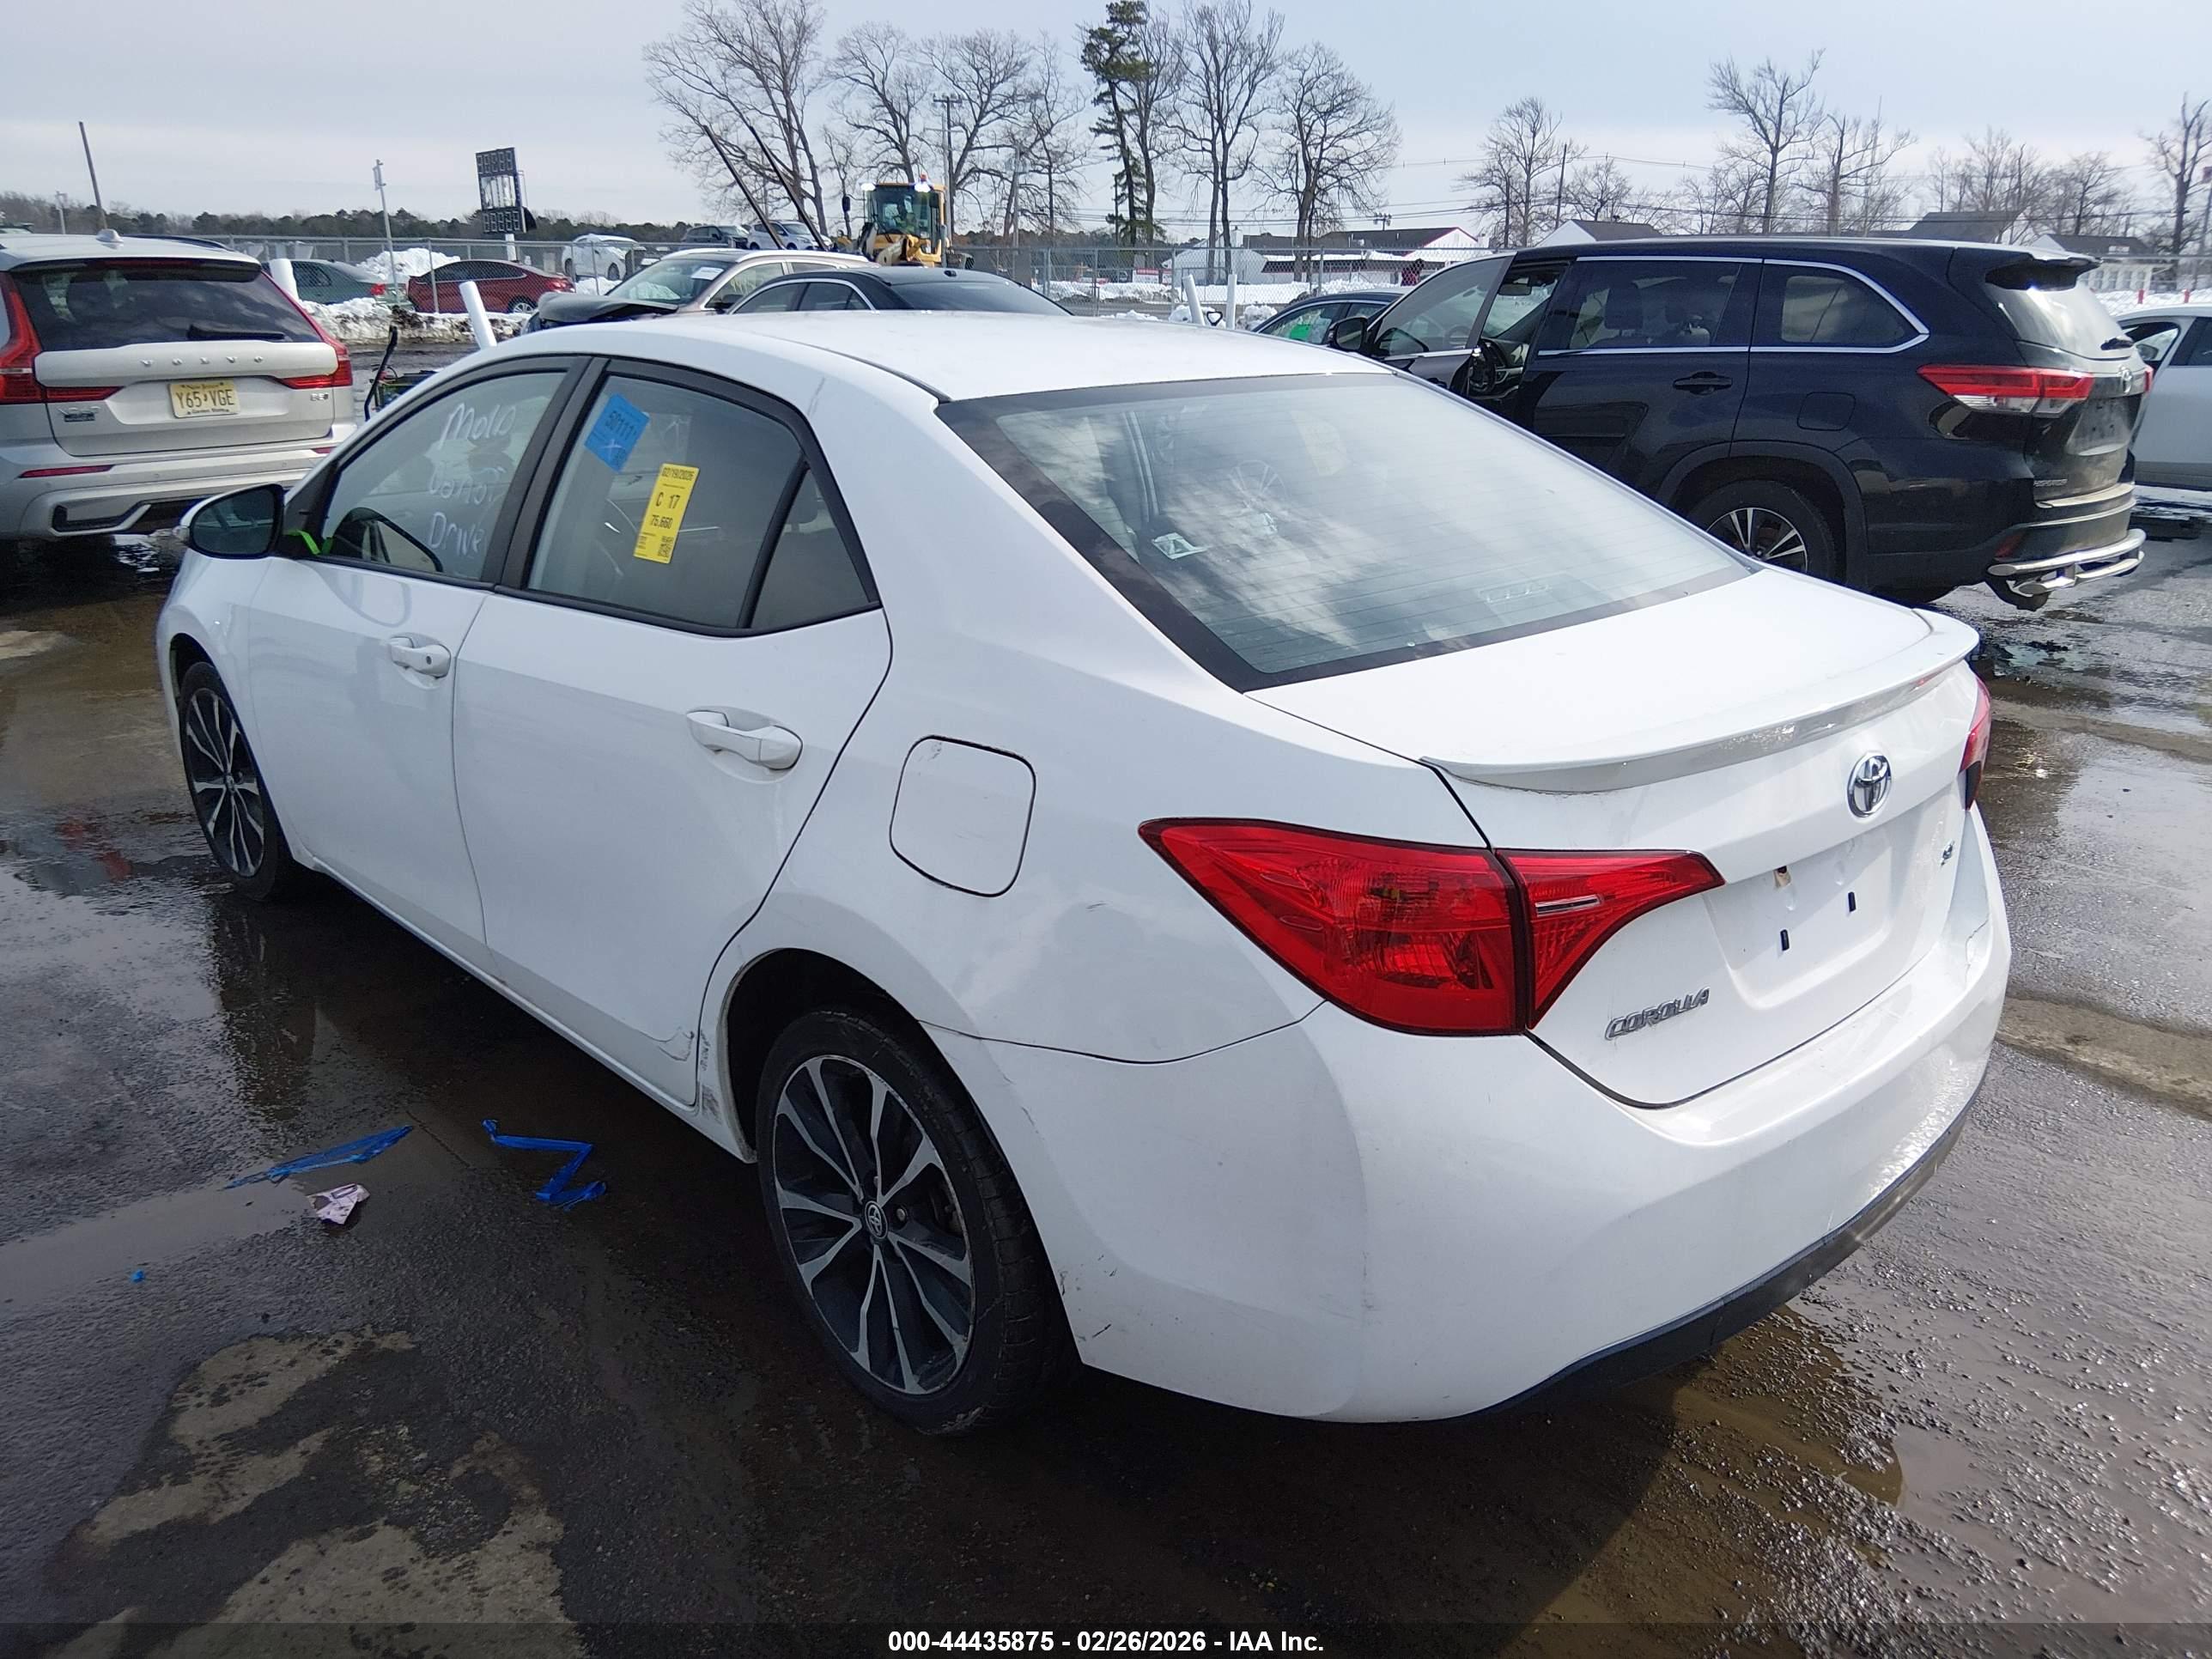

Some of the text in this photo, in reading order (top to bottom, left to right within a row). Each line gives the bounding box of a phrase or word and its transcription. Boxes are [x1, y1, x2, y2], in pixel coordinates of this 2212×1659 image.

[141, 355, 264, 367] VOLVO
[655, 492, 681, 509] C 17
[1604, 985, 1711, 1041] COROLLA
